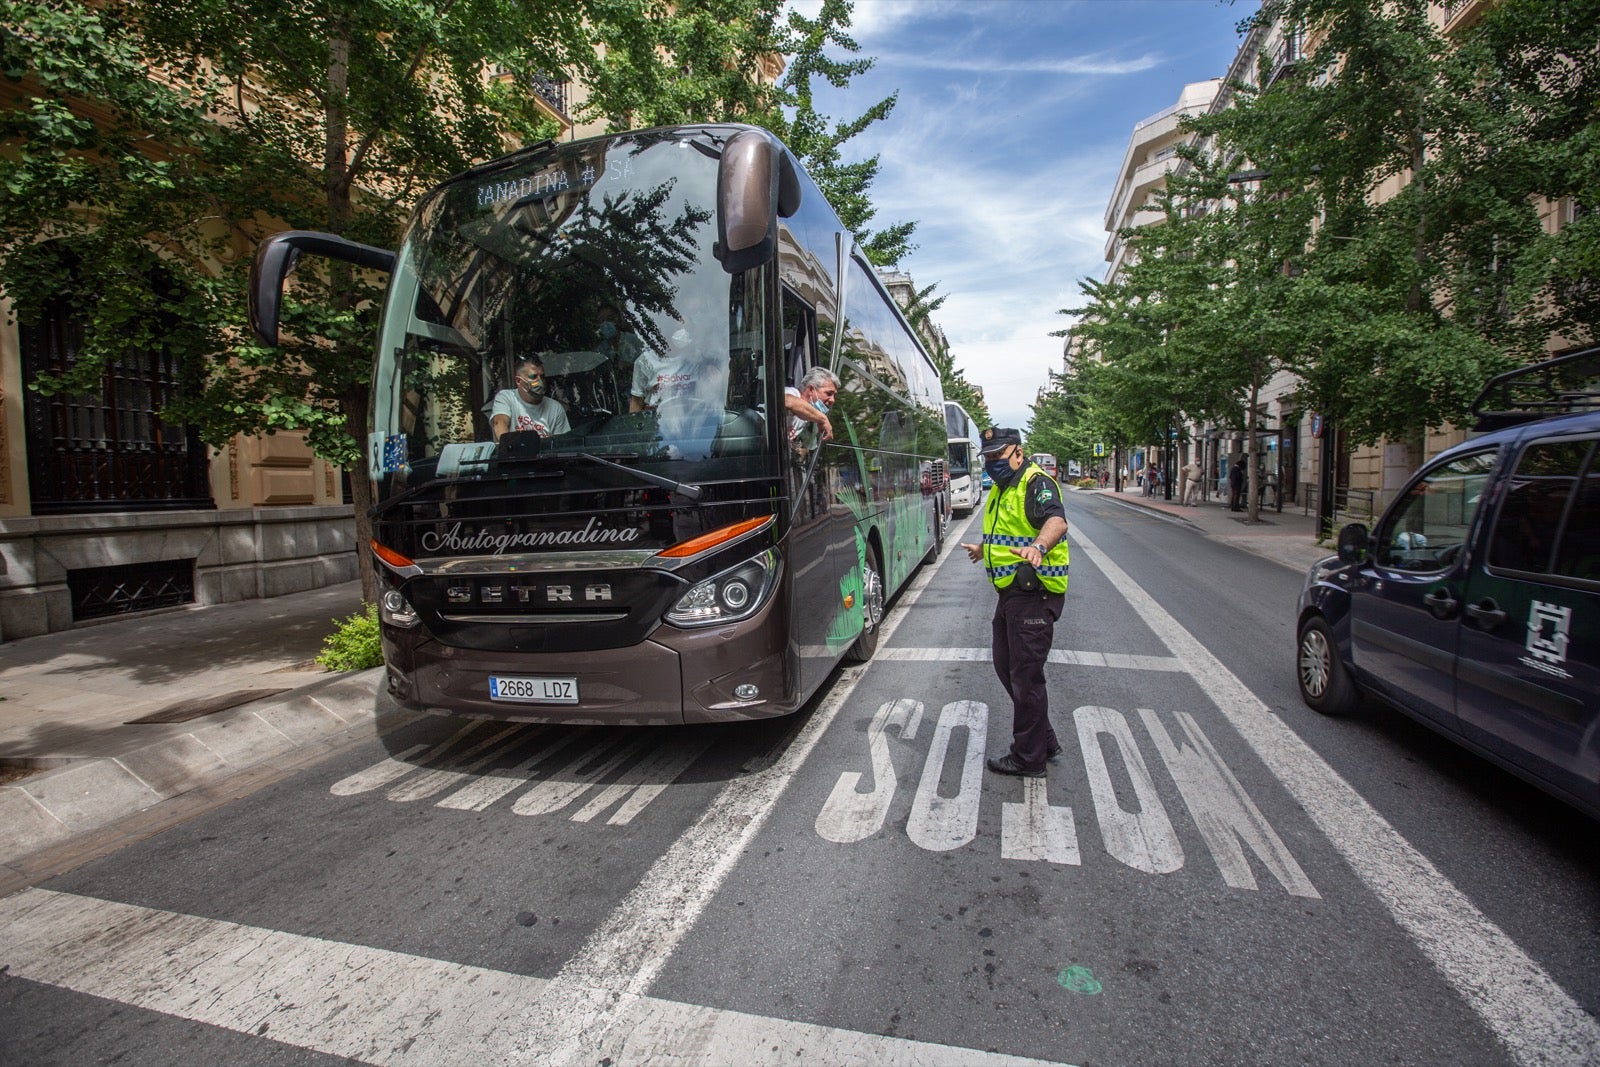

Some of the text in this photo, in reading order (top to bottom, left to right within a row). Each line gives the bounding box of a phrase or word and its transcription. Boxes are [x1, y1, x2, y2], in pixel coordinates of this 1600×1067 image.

[517, 415, 545, 432] #Savar
[421, 516, 639, 558] Autogranadina
[447, 583, 612, 603] SETRA
[500, 680, 534, 697] 2668
[543, 681, 573, 698] LDZ
